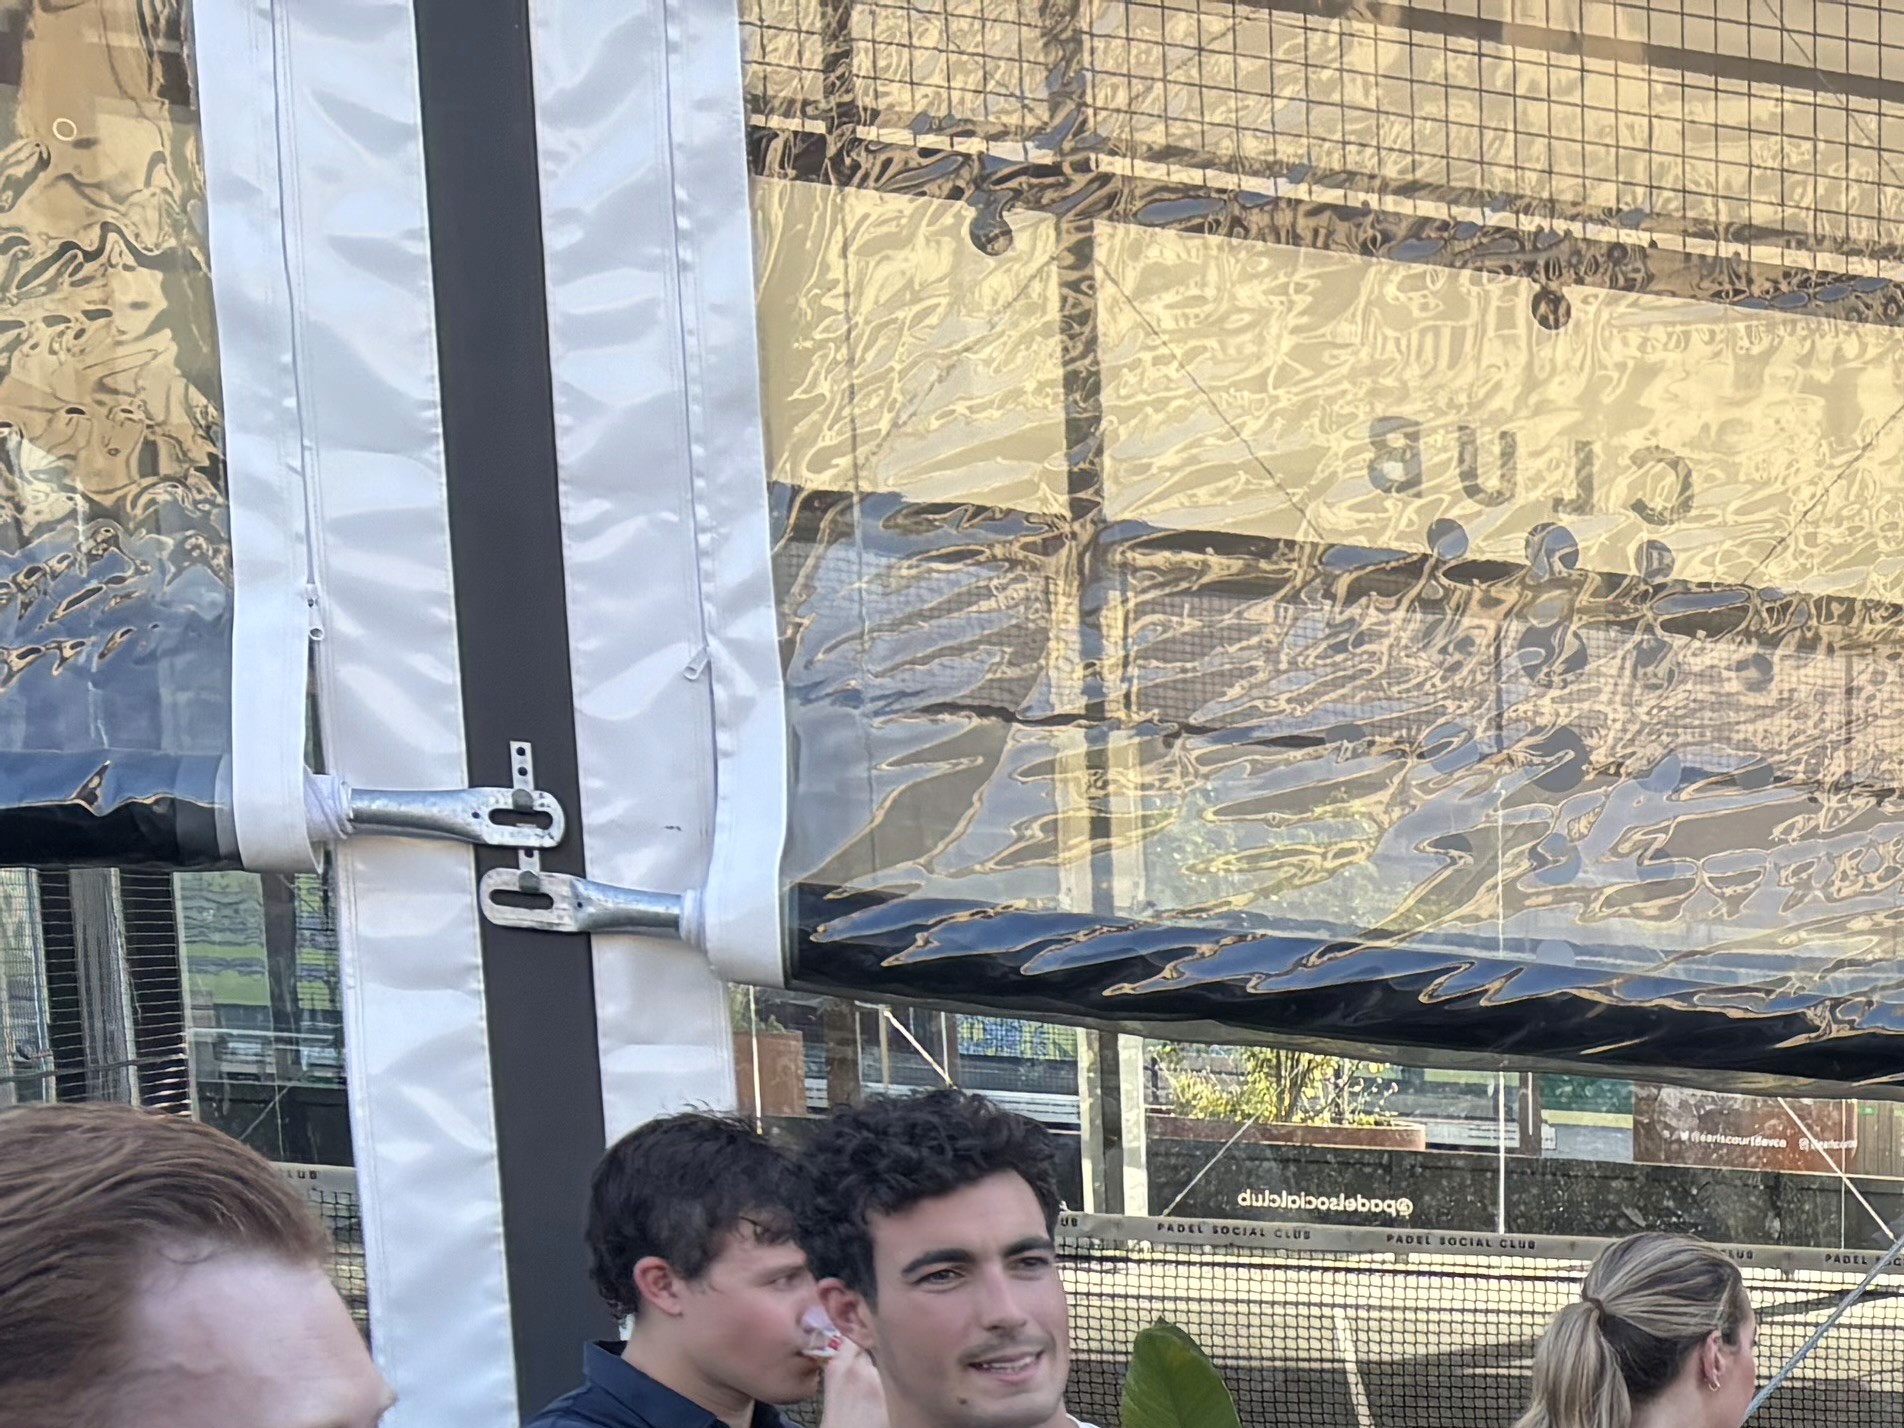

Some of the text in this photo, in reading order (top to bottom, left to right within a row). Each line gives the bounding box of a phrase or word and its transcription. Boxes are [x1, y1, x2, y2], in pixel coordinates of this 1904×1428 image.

[1156, 1222, 1312, 1241] PADEL SOCIAL CLUB
[1386, 1233, 1537, 1250] PADEL SOCIAL CLUB
[1824, 1253, 1868, 1267] PADEL
